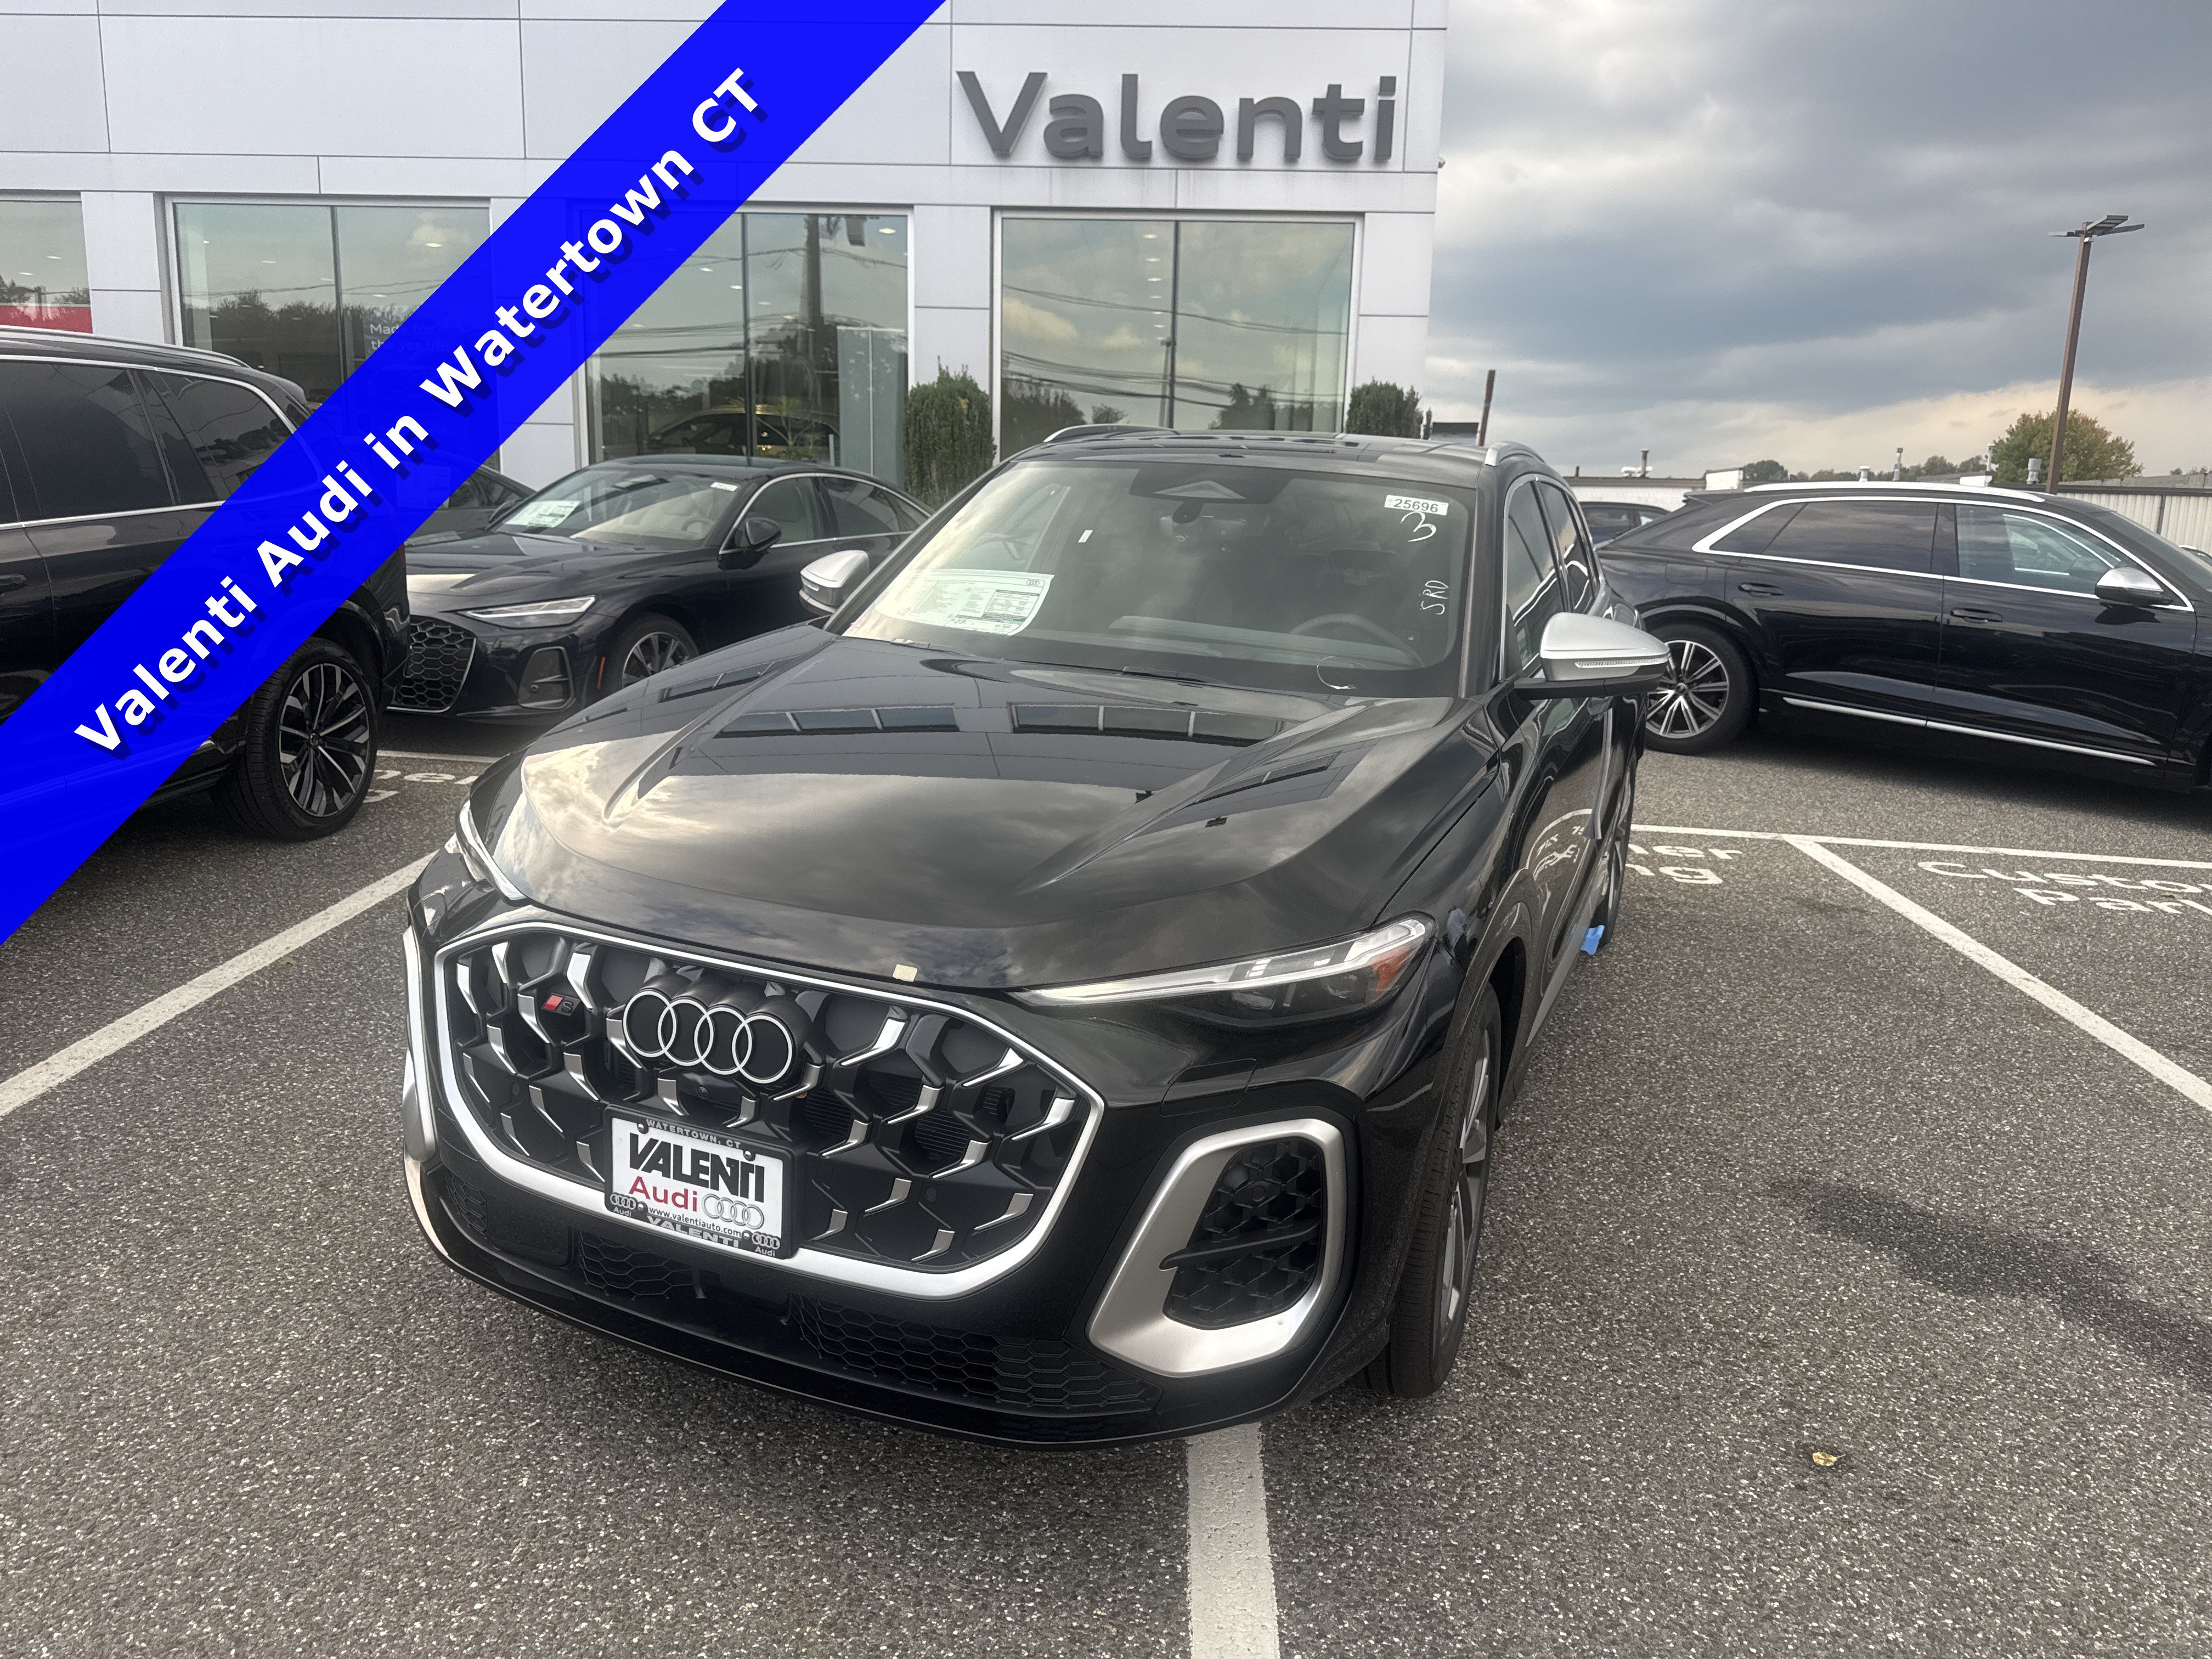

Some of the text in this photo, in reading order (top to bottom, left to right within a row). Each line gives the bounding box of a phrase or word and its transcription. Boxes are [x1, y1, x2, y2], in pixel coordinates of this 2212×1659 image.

[956, 71, 1396, 159] Valenti
[1393, 499, 1438, 513] 25696
[1400, 511, 1436, 542] 3
[1917, 861, 2212, 894] Custo
[646, 1119, 741, 1149] WATERTOWN, CT
[630, 1133, 764, 1203] VALENTI
[629, 1176, 697, 1212] Audi
[613, 1206, 632, 1217] Audi
[649, 1207, 741, 1237] www.valentiauto.com
[647, 1215, 739, 1248] VALENTI
[755, 1246, 775, 1257] Audi
